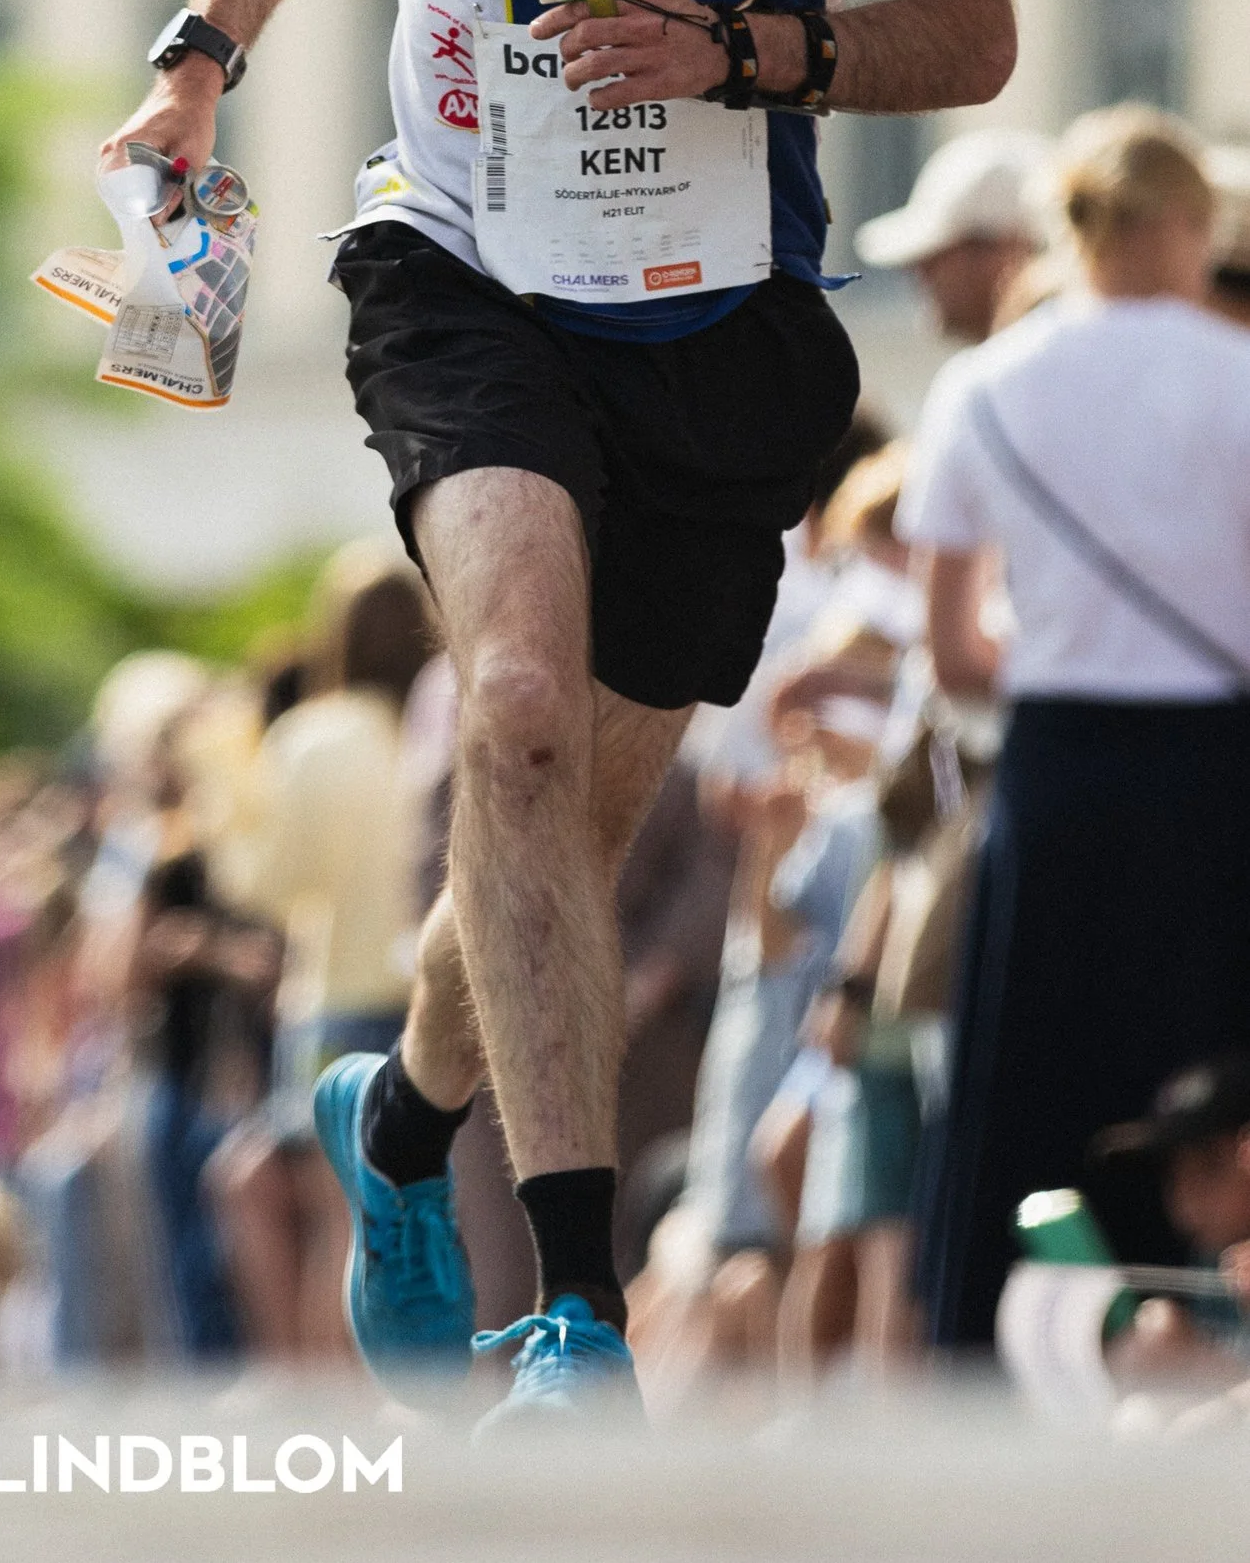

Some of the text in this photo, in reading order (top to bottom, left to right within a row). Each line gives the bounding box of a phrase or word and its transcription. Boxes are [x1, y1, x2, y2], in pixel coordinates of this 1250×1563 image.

[575, 102, 667, 132] 12813
[580, 147, 666, 176] KENT
[602, 206, 646, 219] H21 ELIT
[51, 267, 124, 309] HALMERS
[551, 274, 630, 287] CHALMERS
[109, 363, 205, 396] CHALMERS
